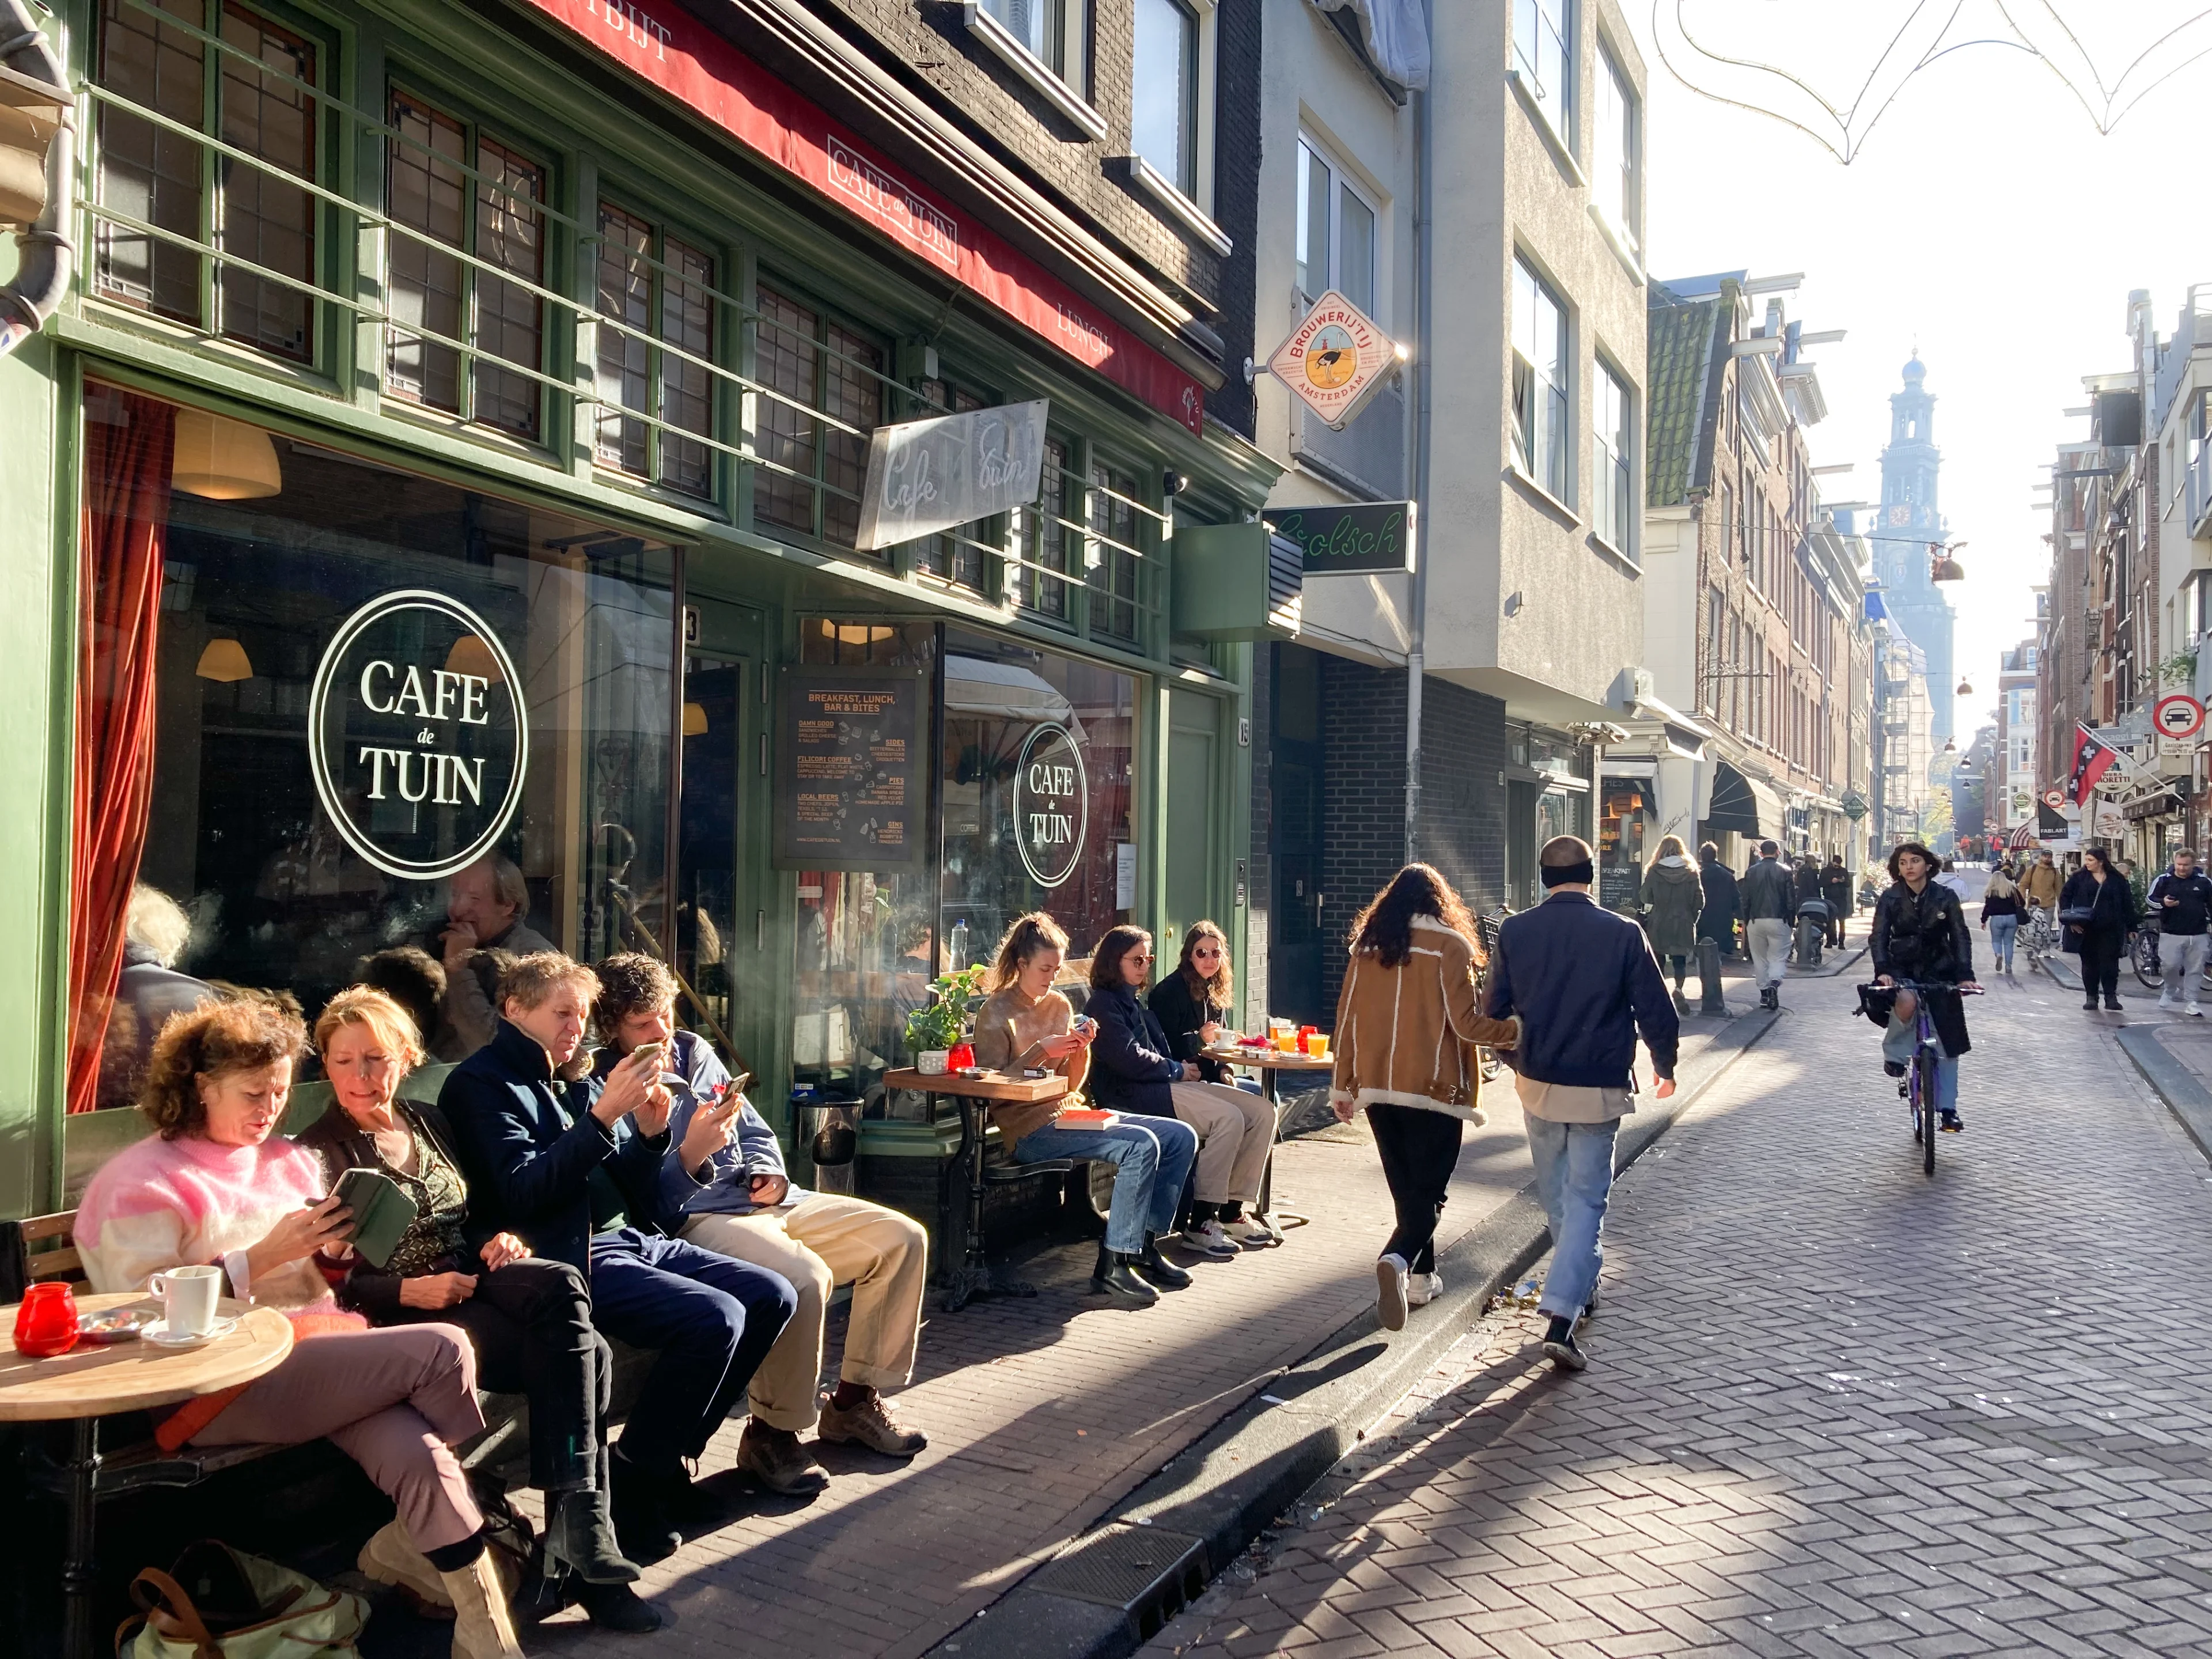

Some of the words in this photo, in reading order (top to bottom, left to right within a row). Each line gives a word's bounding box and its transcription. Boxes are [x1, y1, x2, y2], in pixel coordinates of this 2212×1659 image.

[833, 150, 891, 212] CAFE
[893, 199, 905, 215] de
[905, 195, 953, 255] TUIN
[1057, 302, 1109, 360] LUNCH
[1298, 375, 1365, 400] AMSTERDAM
[361, 660, 488, 725] CAFE
[809, 694, 861, 704] BREAKFAST,
[863, 695, 896, 705] LUNCH,
[824, 703, 842, 711] BAR
[853, 704, 880, 713] BITES
[417, 727, 434, 745] de
[1241, 723, 1248, 743] 15
[359, 747, 486, 806] TUIN
[1029, 764, 1074, 796] CAFE
[1048, 800, 1056, 810] de
[1029, 813, 1073, 843] TUIN
